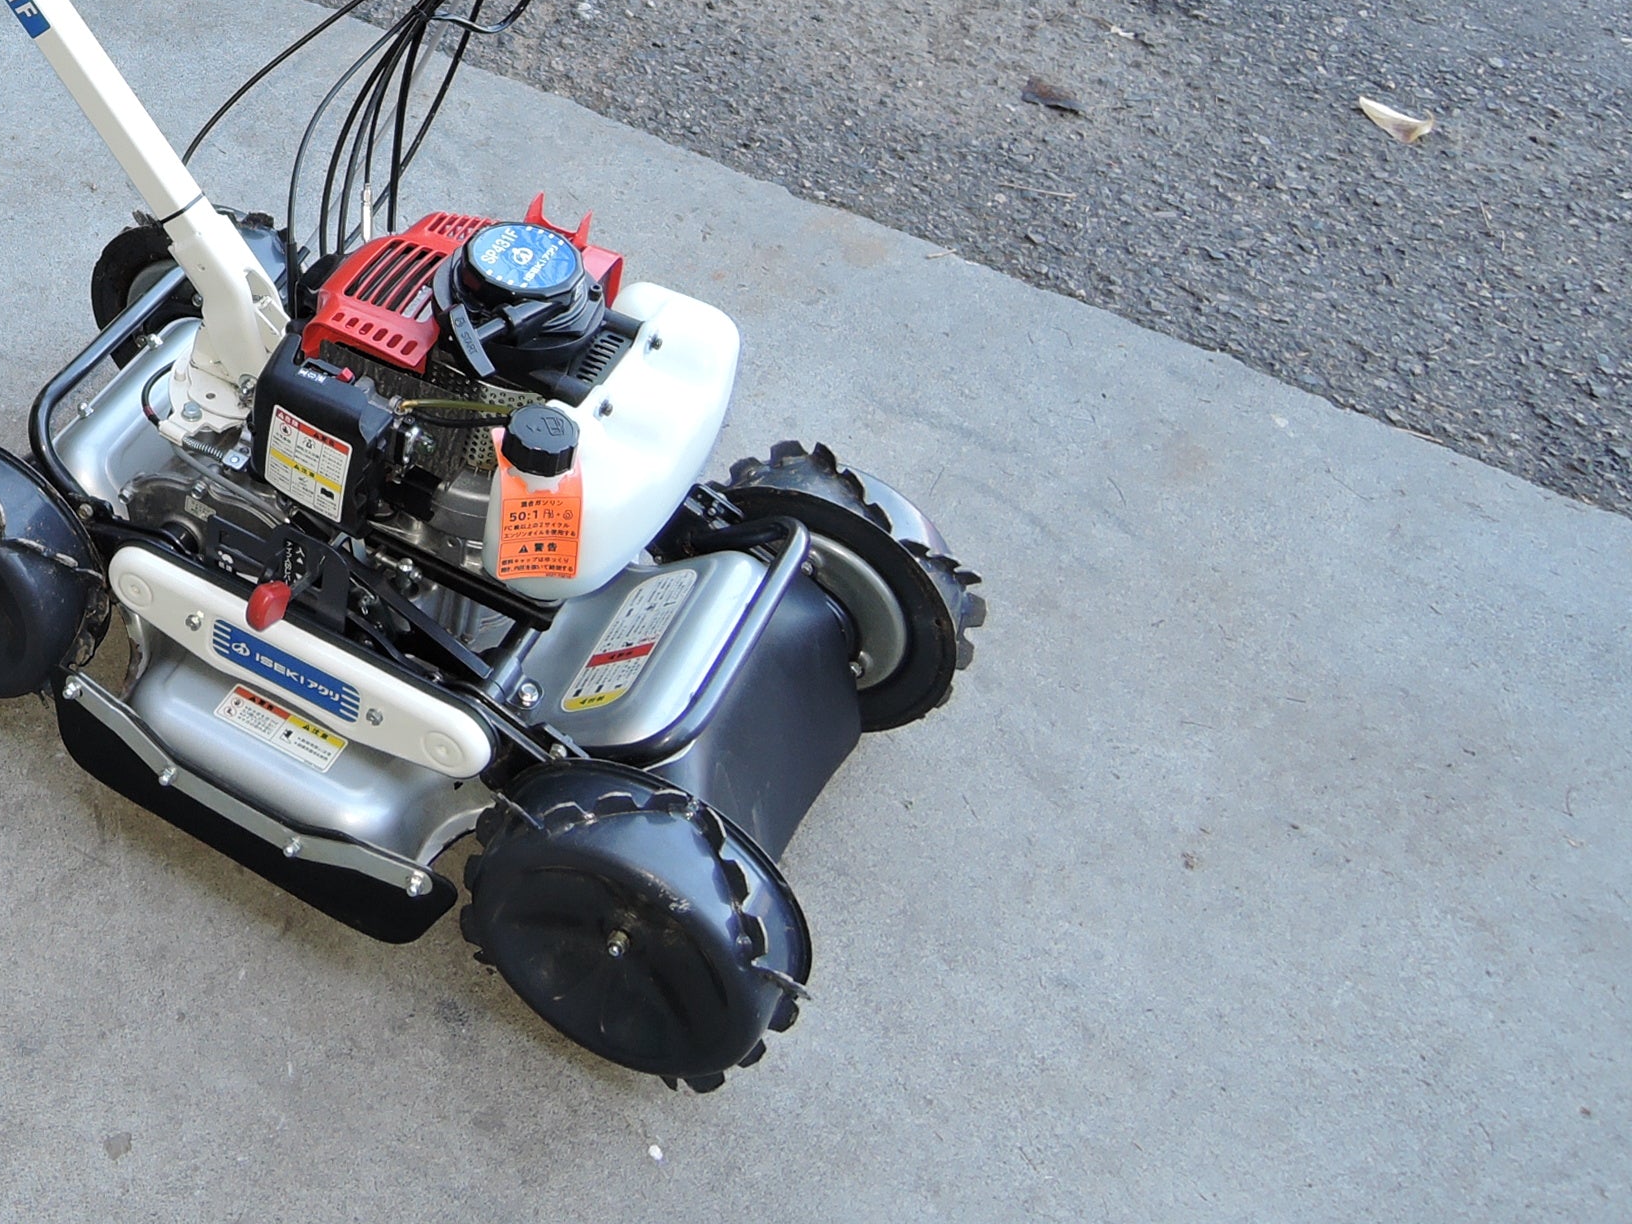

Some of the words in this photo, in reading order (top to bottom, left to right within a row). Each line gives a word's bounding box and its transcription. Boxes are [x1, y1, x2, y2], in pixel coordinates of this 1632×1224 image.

[481, 226, 519, 265] SP431F
[461, 331, 478, 355] START
[509, 509, 539, 522] 50:1
